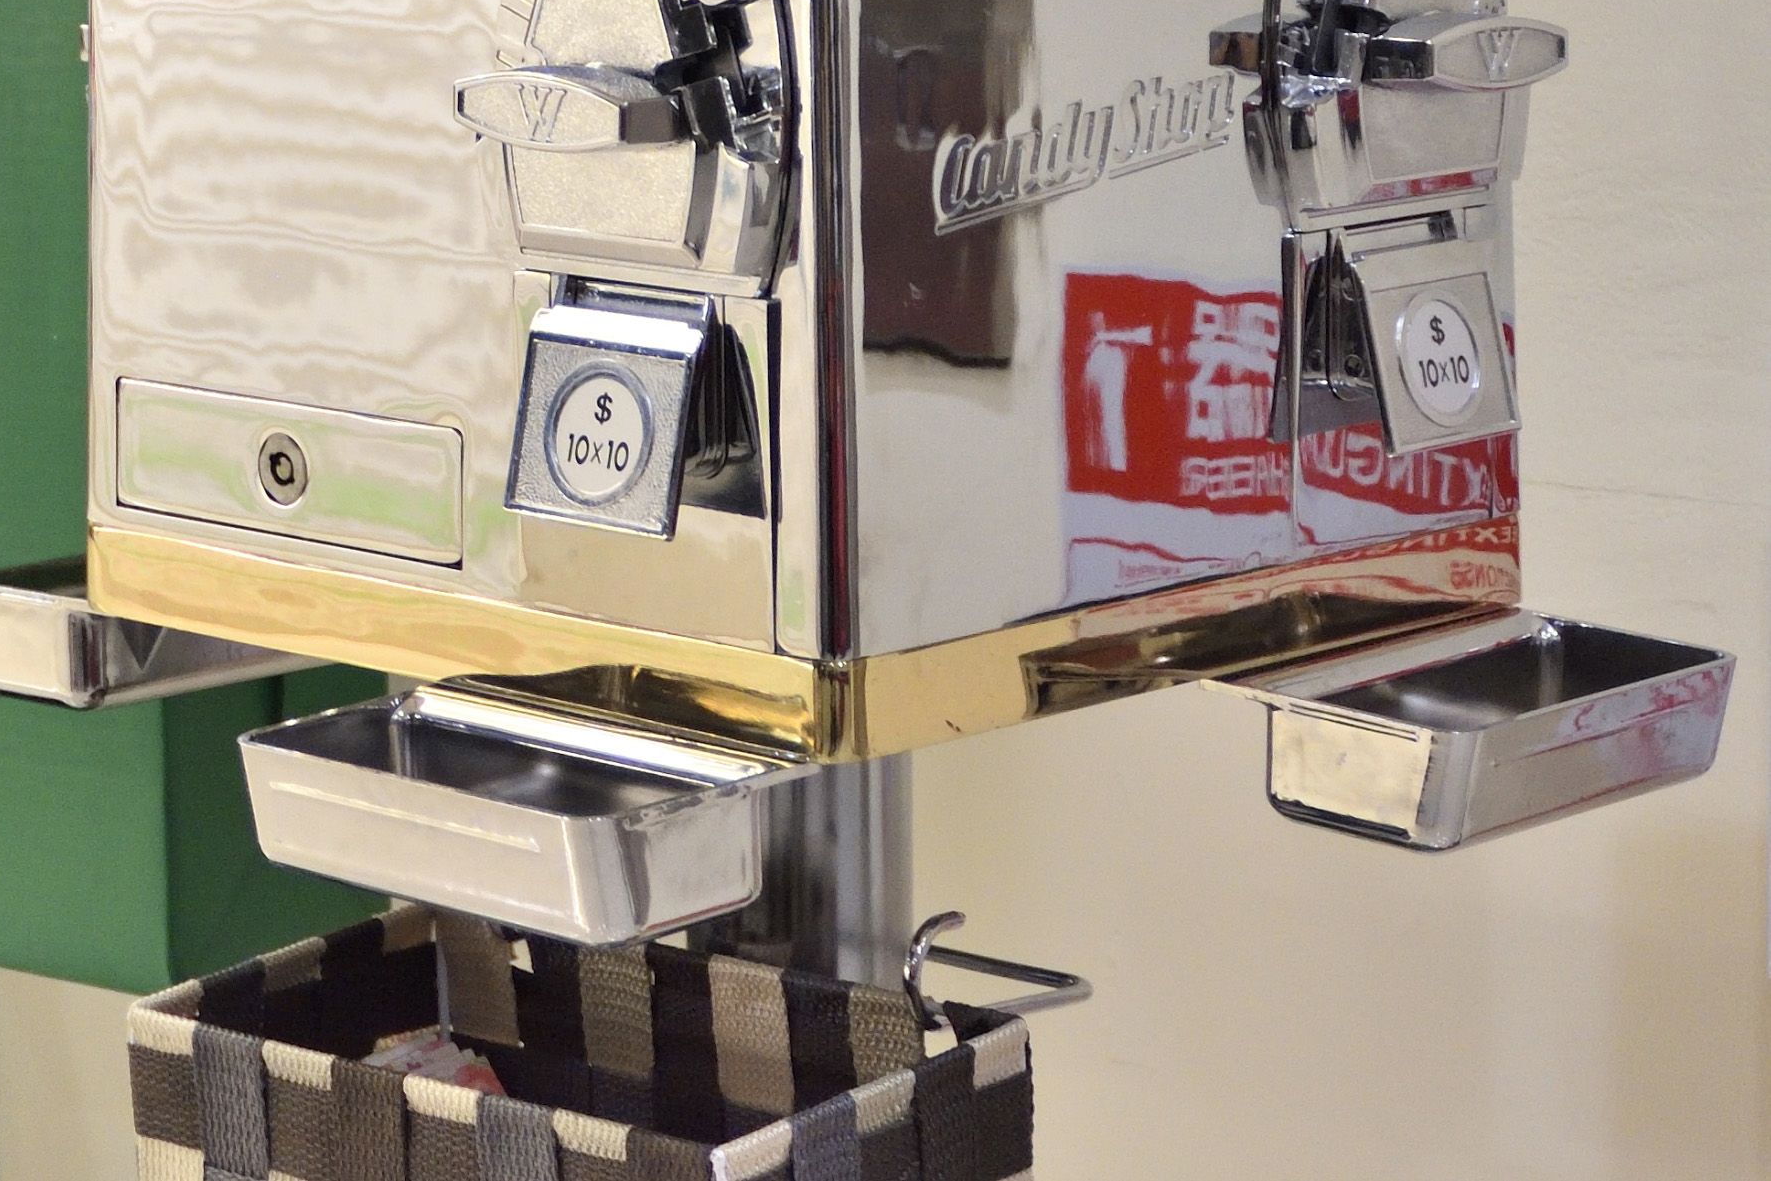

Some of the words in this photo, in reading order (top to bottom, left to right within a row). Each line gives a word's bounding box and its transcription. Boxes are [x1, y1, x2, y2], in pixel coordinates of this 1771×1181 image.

[933, 98, 1115, 233] Candy
[1430, 315, 1446, 346] $
[594, 392, 613, 423] $
